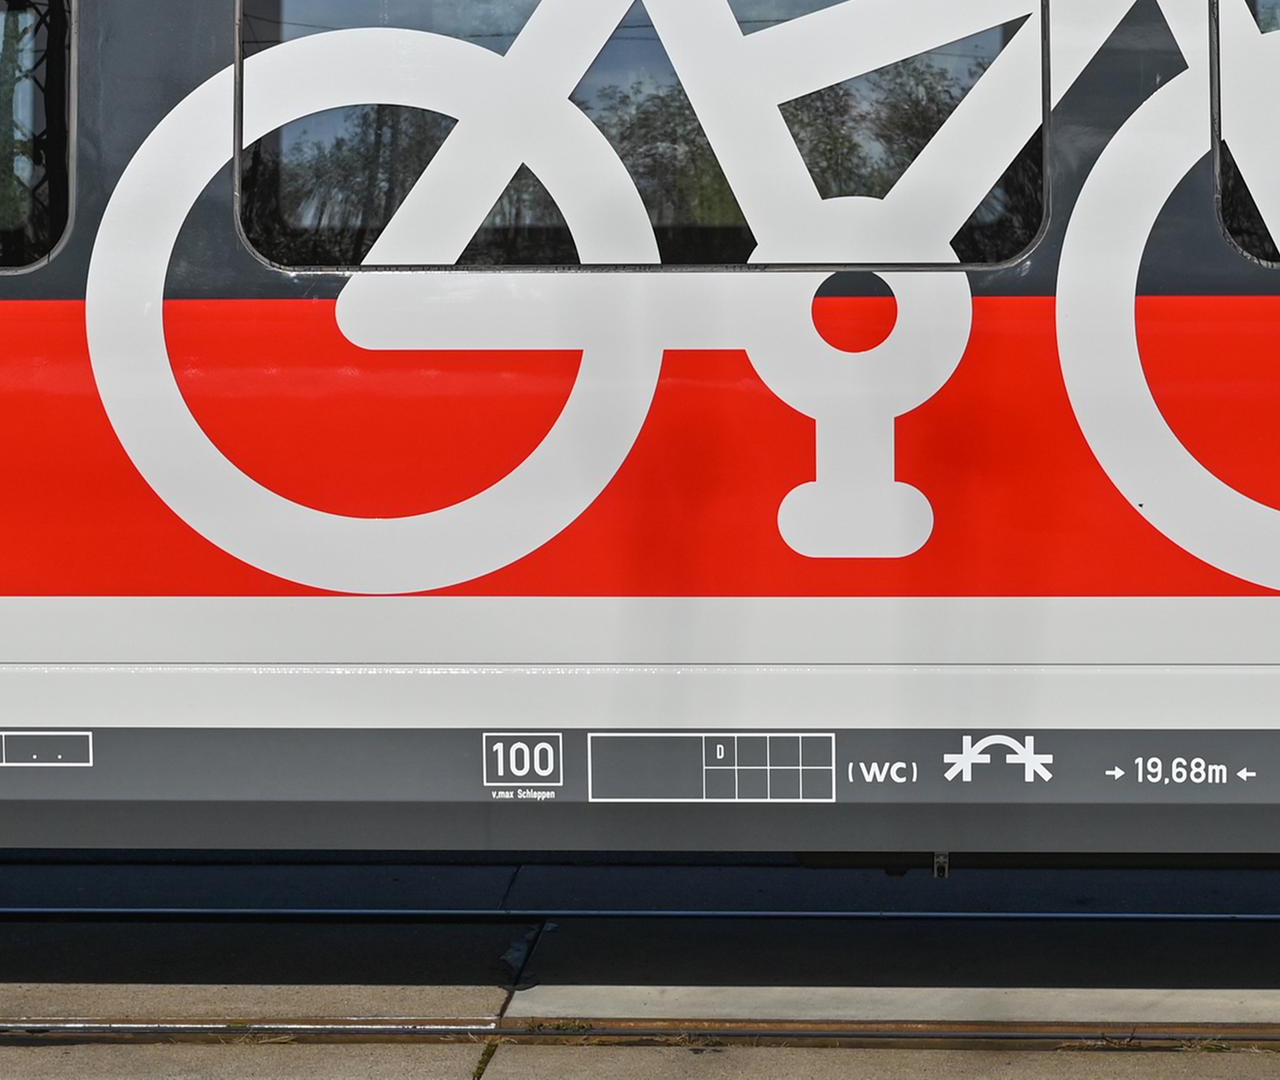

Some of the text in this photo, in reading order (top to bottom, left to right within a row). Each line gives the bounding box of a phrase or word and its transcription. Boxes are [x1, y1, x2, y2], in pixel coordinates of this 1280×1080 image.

[492, 741, 555, 777] 100
[716, 744, 725, 760] D
[1133, 756, 1228, 785] 19,68m
